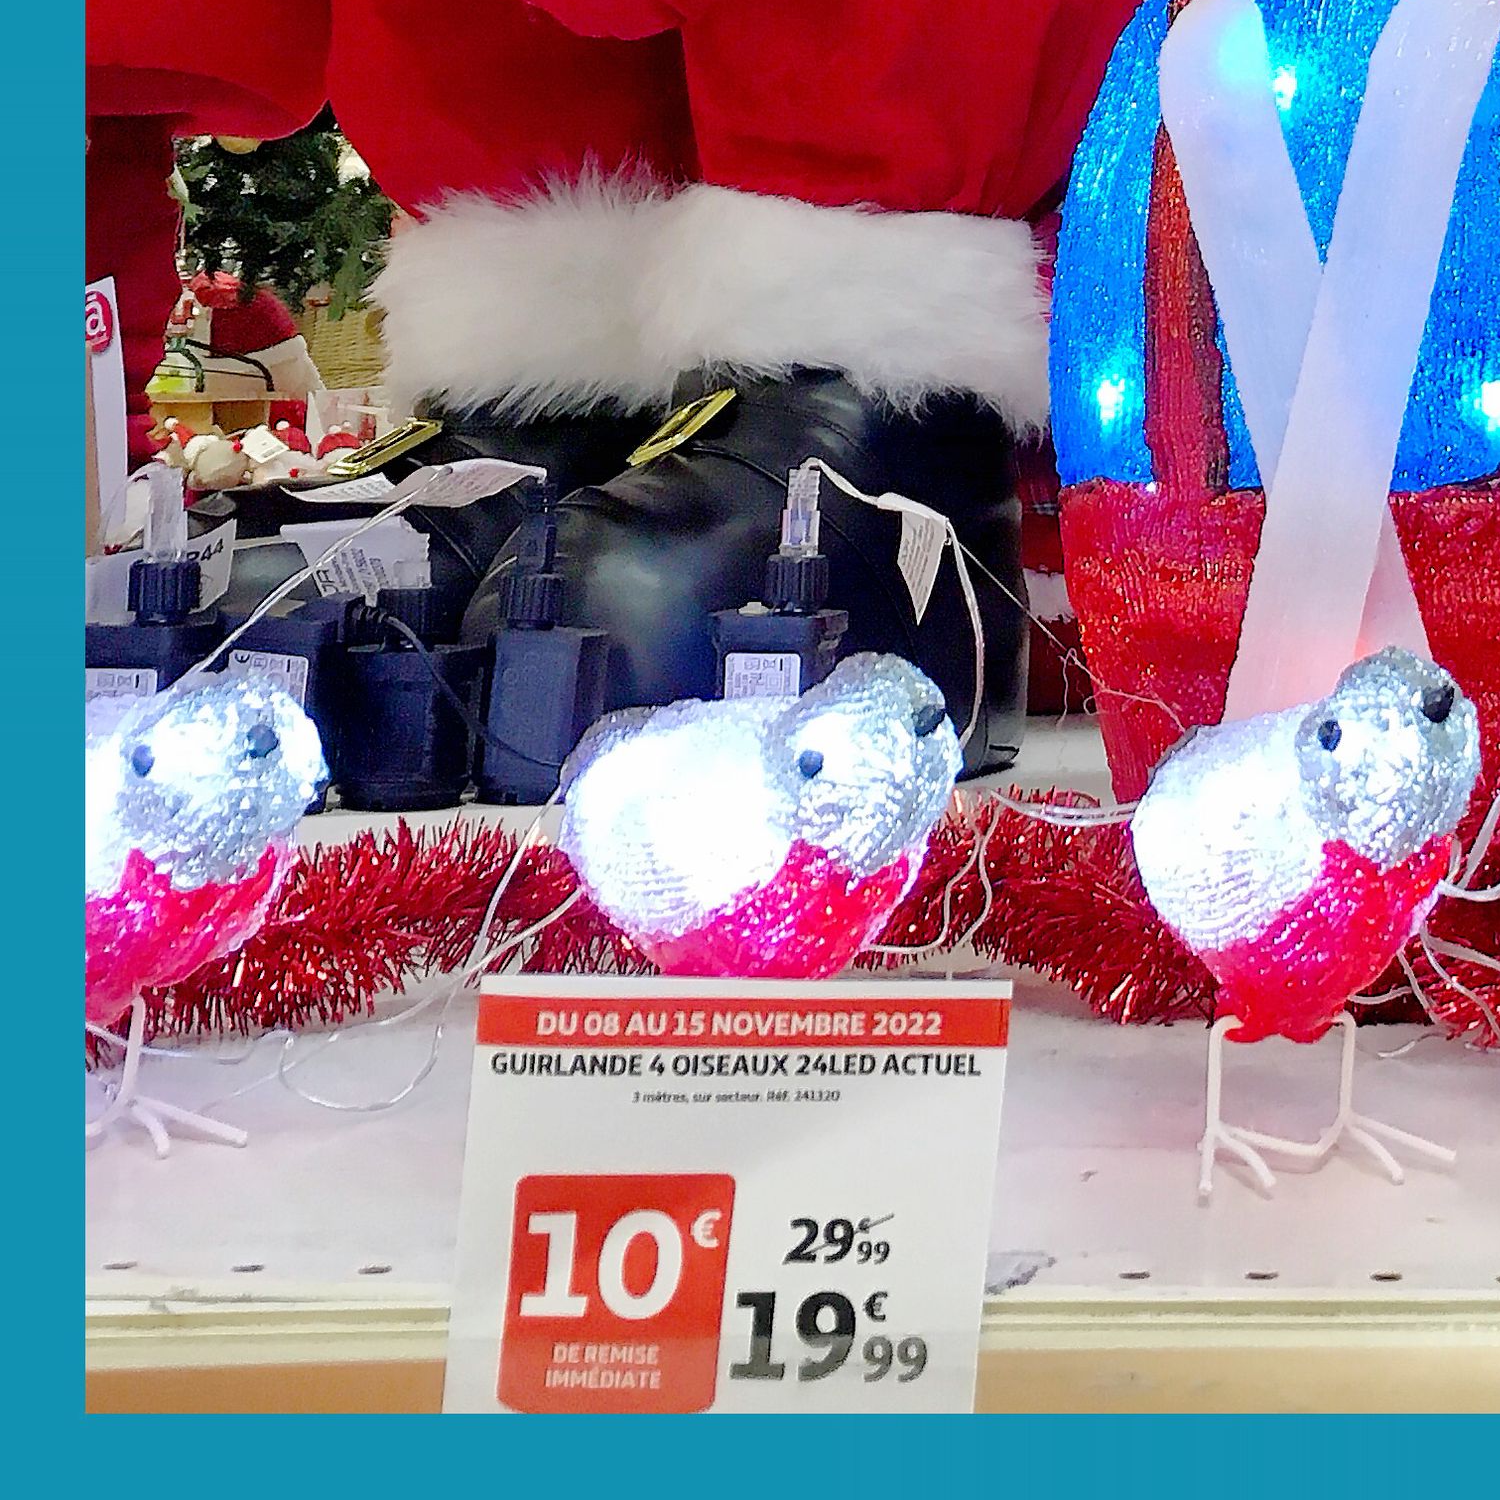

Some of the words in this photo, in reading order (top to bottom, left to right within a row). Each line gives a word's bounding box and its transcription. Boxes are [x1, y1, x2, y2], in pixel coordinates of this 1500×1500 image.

[536, 1010, 578, 1036] DU
[583, 1010, 621, 1036] 08
[624, 1010, 667, 1036] AU
[672, 1011, 706, 1036] 15
[711, 1010, 866, 1037] NOVEMBRE
[871, 1011, 943, 1037] 2022
[490, 1051, 643, 1077] GUIRLANDE
[649, 1052, 665, 1077] 4
[671, 1052, 788, 1077] OISEAUX
[794, 1053, 876, 1077] 24LED
[882, 1052, 982, 1077] ACTUEL
[692, 1092, 712, 1103] sur
[519, 1207, 722, 1320] 10€
[553, 1343, 581, 1365] DE
[584, 1343, 659, 1366] REMISE
[544, 1367, 662, 1390] IMMÉDIATE
